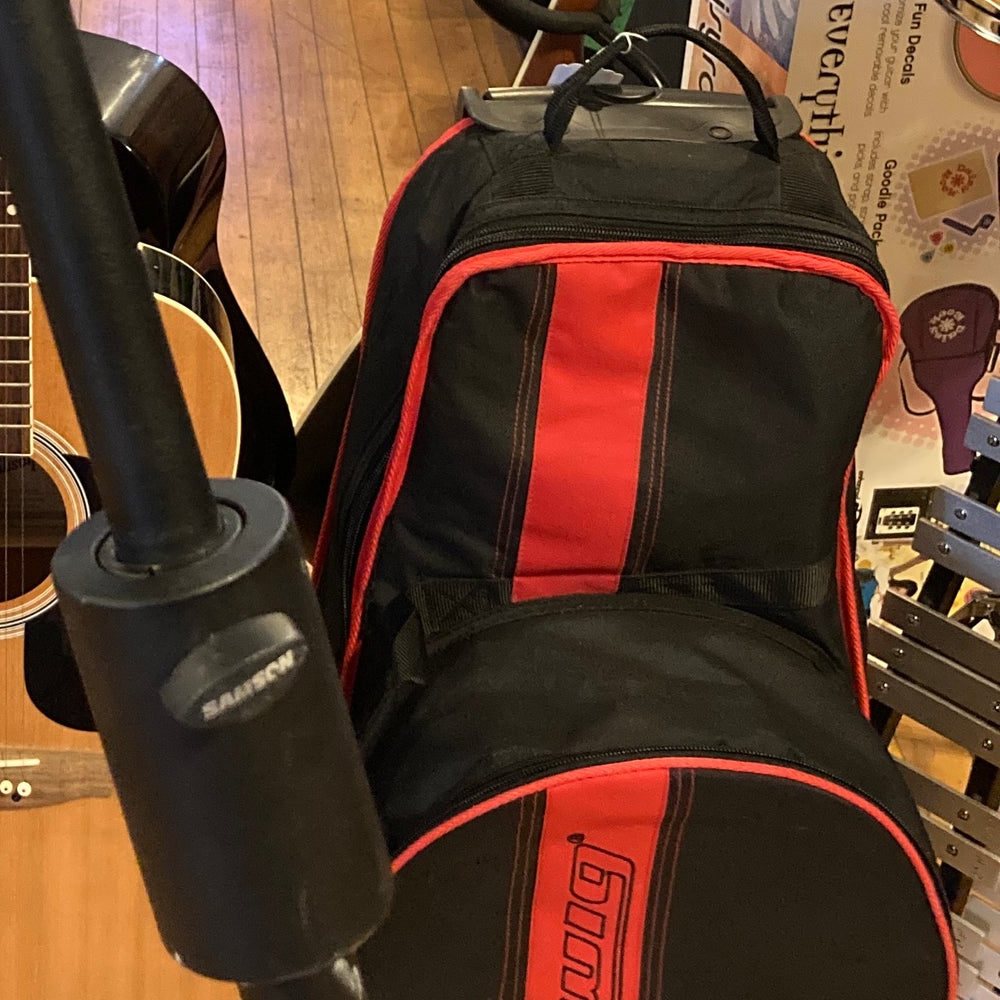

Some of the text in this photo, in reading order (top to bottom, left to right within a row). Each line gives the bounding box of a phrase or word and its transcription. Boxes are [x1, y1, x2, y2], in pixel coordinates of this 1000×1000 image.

[900, 3, 927, 85] Fun Decals
[877, 159, 897, 209] Goodie
